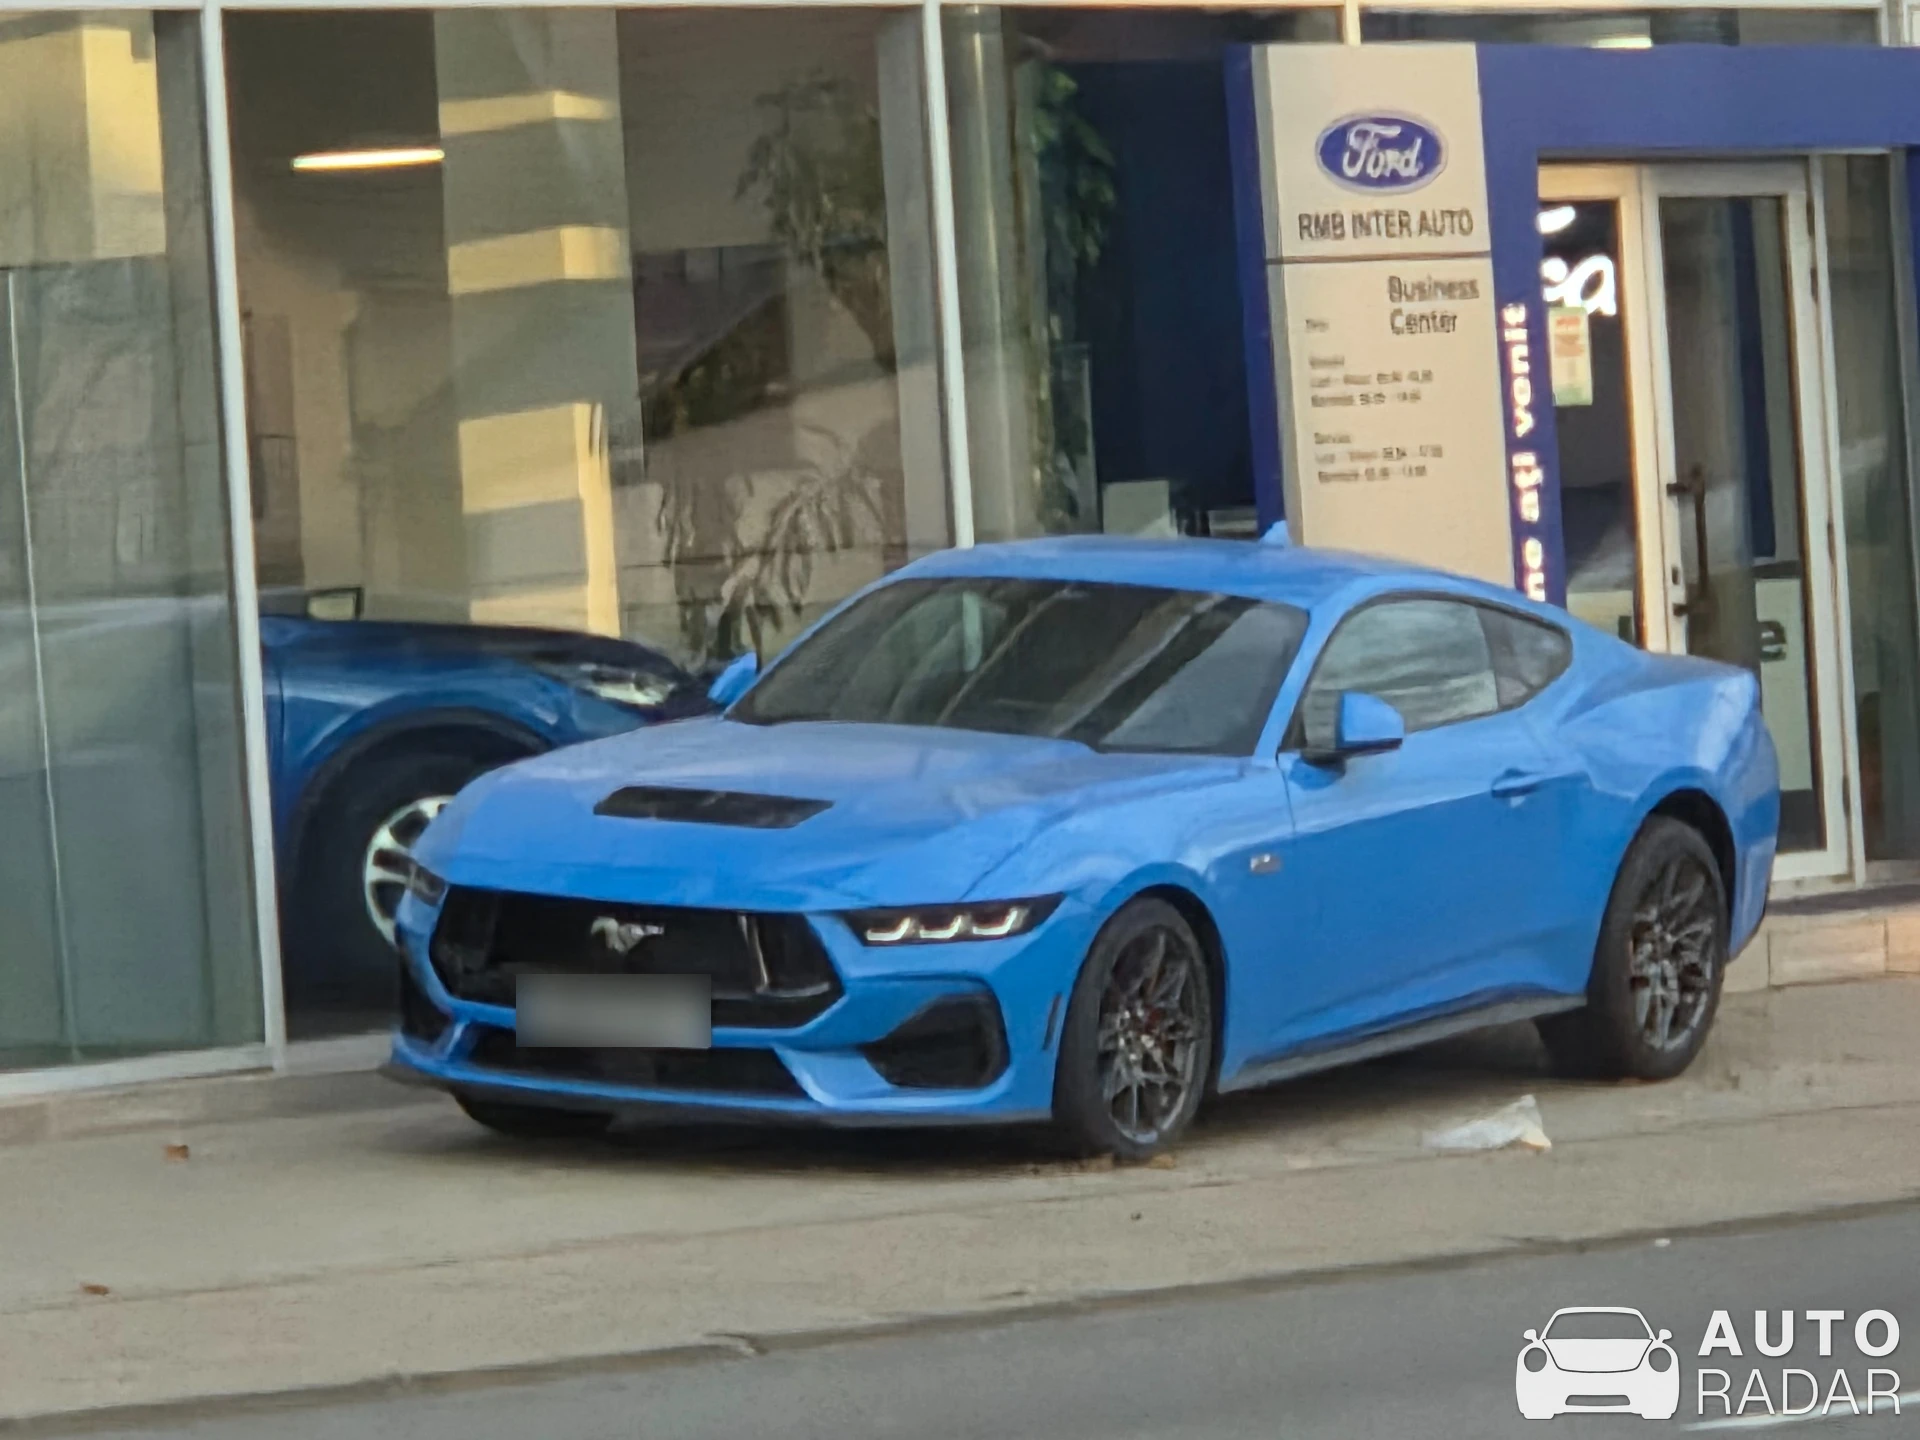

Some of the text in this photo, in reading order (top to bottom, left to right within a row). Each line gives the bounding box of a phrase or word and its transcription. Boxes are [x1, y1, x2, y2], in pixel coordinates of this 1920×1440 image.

[1342, 123, 1422, 178] Ford
[1298, 207, 1474, 240] RMB INTER AUTO
[1388, 274, 1480, 303] Business
[1390, 308, 1457, 335] Center
